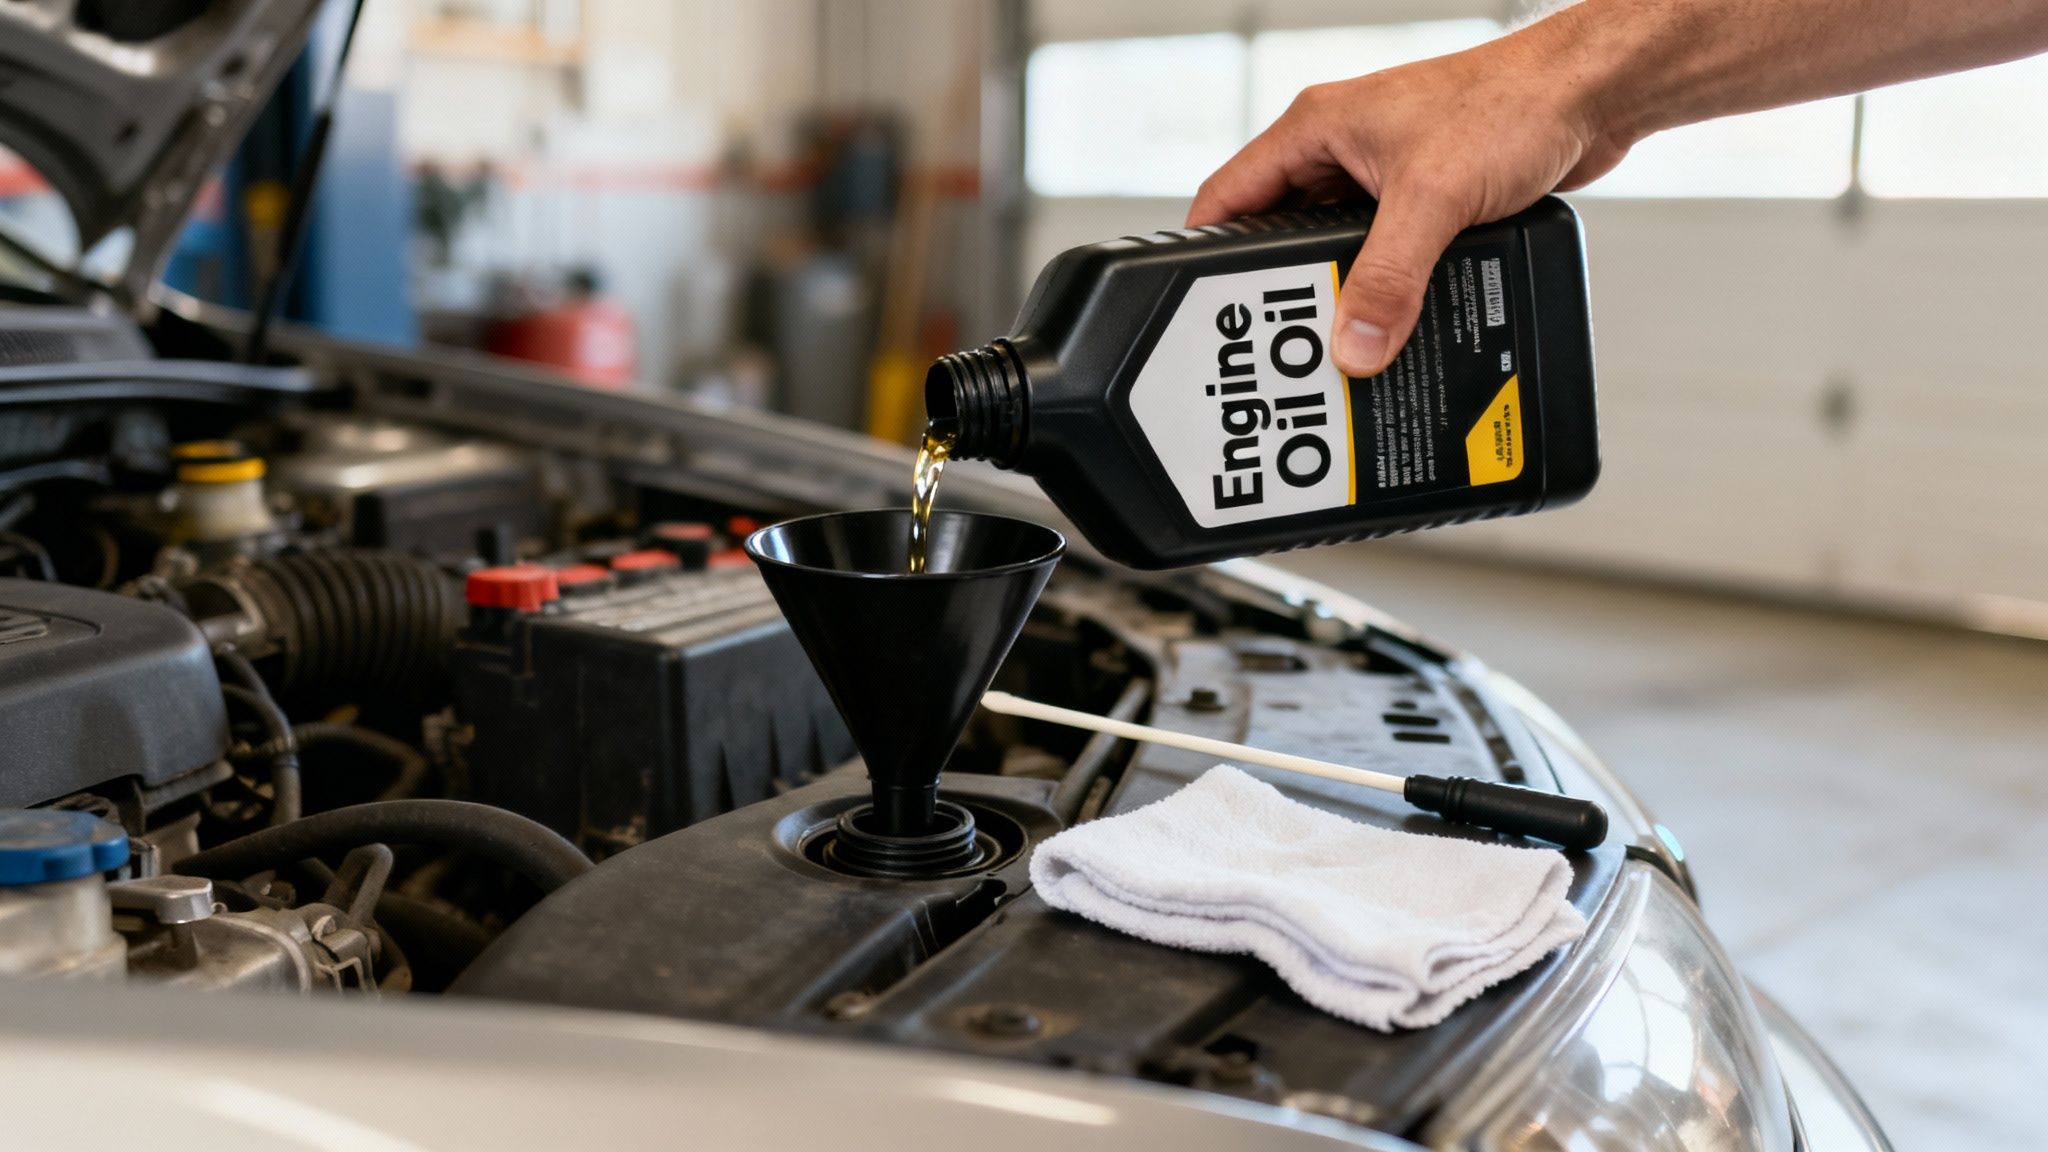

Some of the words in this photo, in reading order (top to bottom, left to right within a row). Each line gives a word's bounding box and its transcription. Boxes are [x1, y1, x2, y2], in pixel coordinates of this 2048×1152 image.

[1262, 283, 1324, 379] Oil
[1206, 303, 1272, 510] Engine
[1273, 391, 1332, 489] Oil
